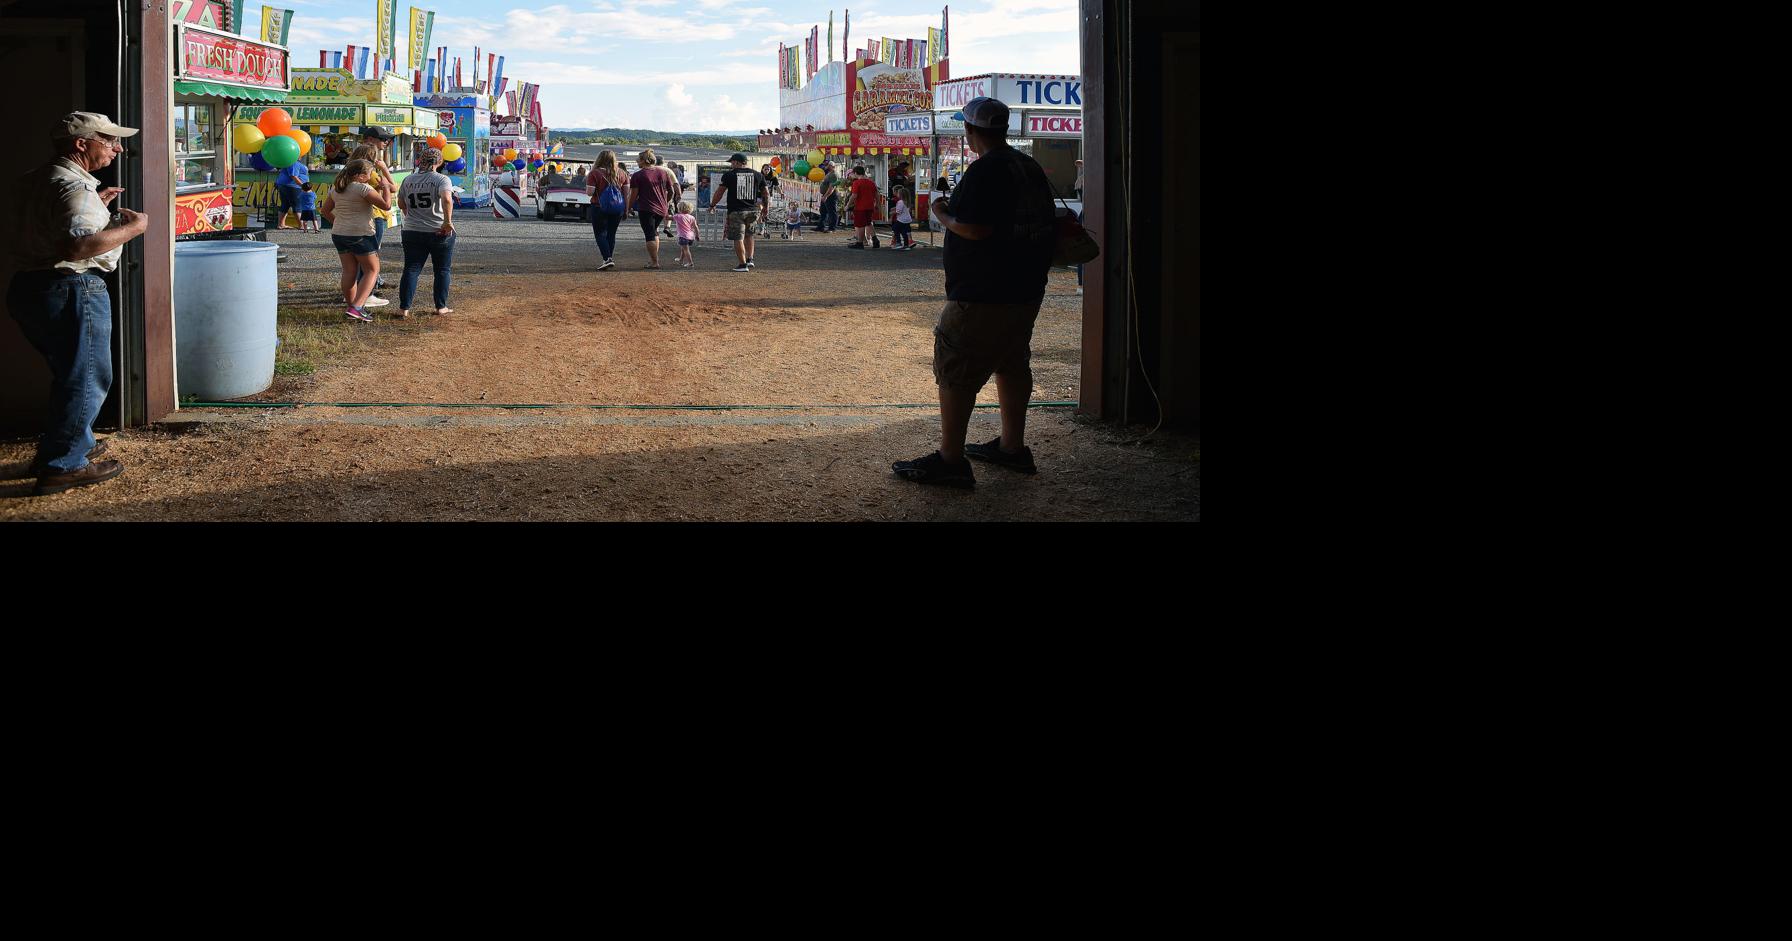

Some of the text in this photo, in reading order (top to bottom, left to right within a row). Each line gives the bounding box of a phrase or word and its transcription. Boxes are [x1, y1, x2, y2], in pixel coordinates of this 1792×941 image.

[187, 41, 283, 81] FRESH DOUGH
[291, 76, 339, 91] NADE
[941, 81, 985, 107] TICKETS
[297, 107, 357, 121] LEMONADE
[889, 117, 930, 131] TICKETS
[408, 193, 431, 208] 15
